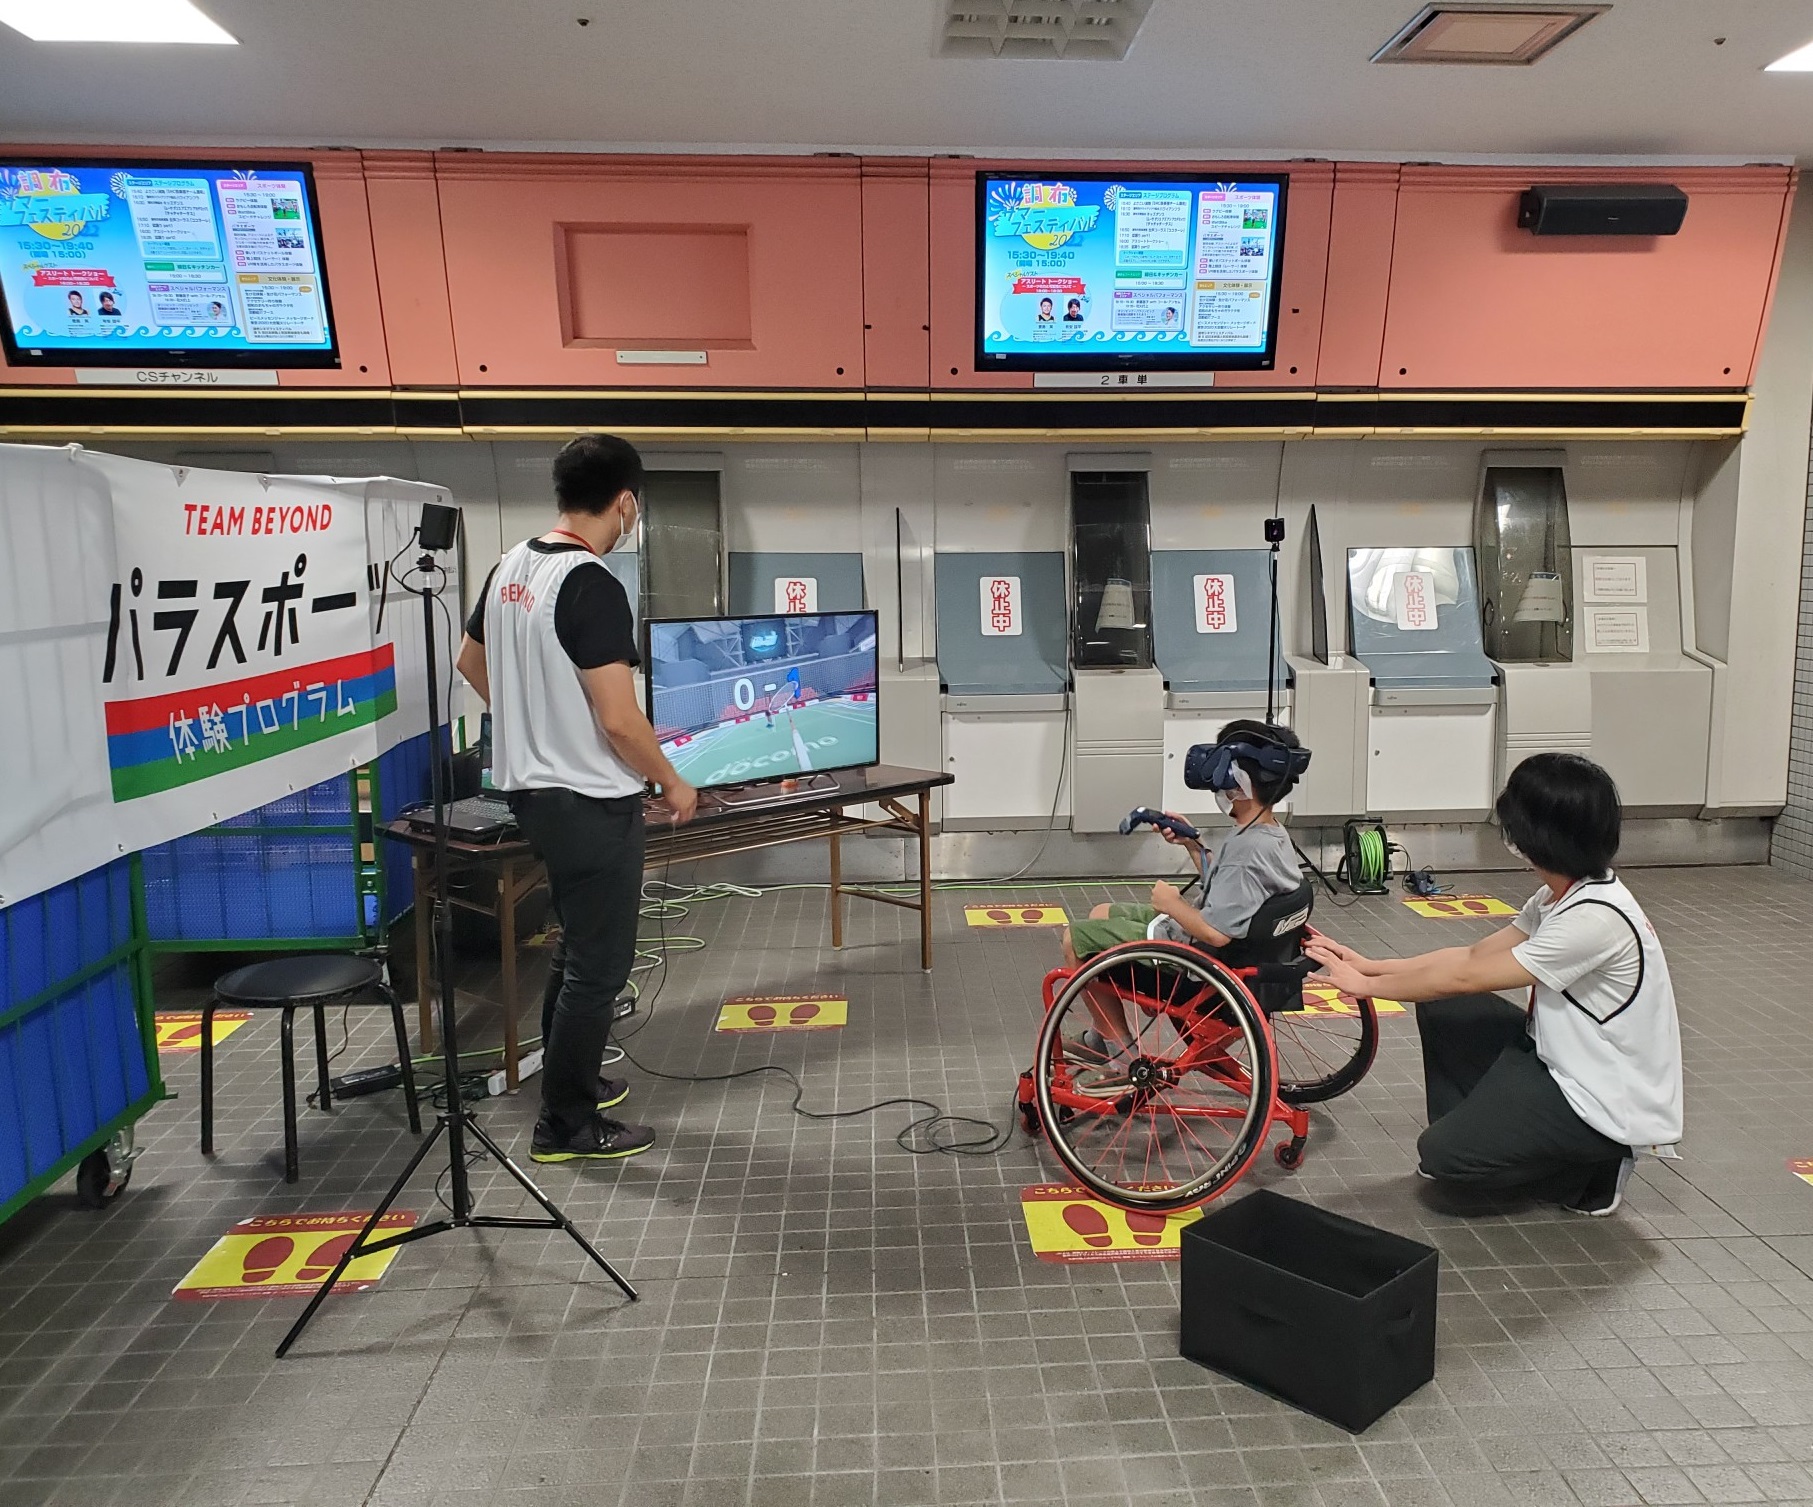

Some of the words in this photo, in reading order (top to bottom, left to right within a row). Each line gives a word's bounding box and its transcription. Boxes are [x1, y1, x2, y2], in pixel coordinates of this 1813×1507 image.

[18, 170, 71, 192] 調布
[1022, 183, 1070, 204] 調布
[15, 205, 105, 224] フェスティバル
[1011, 215, 1097, 234] フェスティバル
[136, 371, 218, 383] CSチャンネル
[184, 504, 245, 536] TEAM
[250, 503, 332, 536] BEYOND
[990, 580, 1011, 632] 休止中
[1204, 577, 1225, 629] 休止中
[1404, 575, 1426, 627] 休止中
[102, 552, 390, 684] パラスポーツ
[168, 678, 356, 766] 体験プログラム
